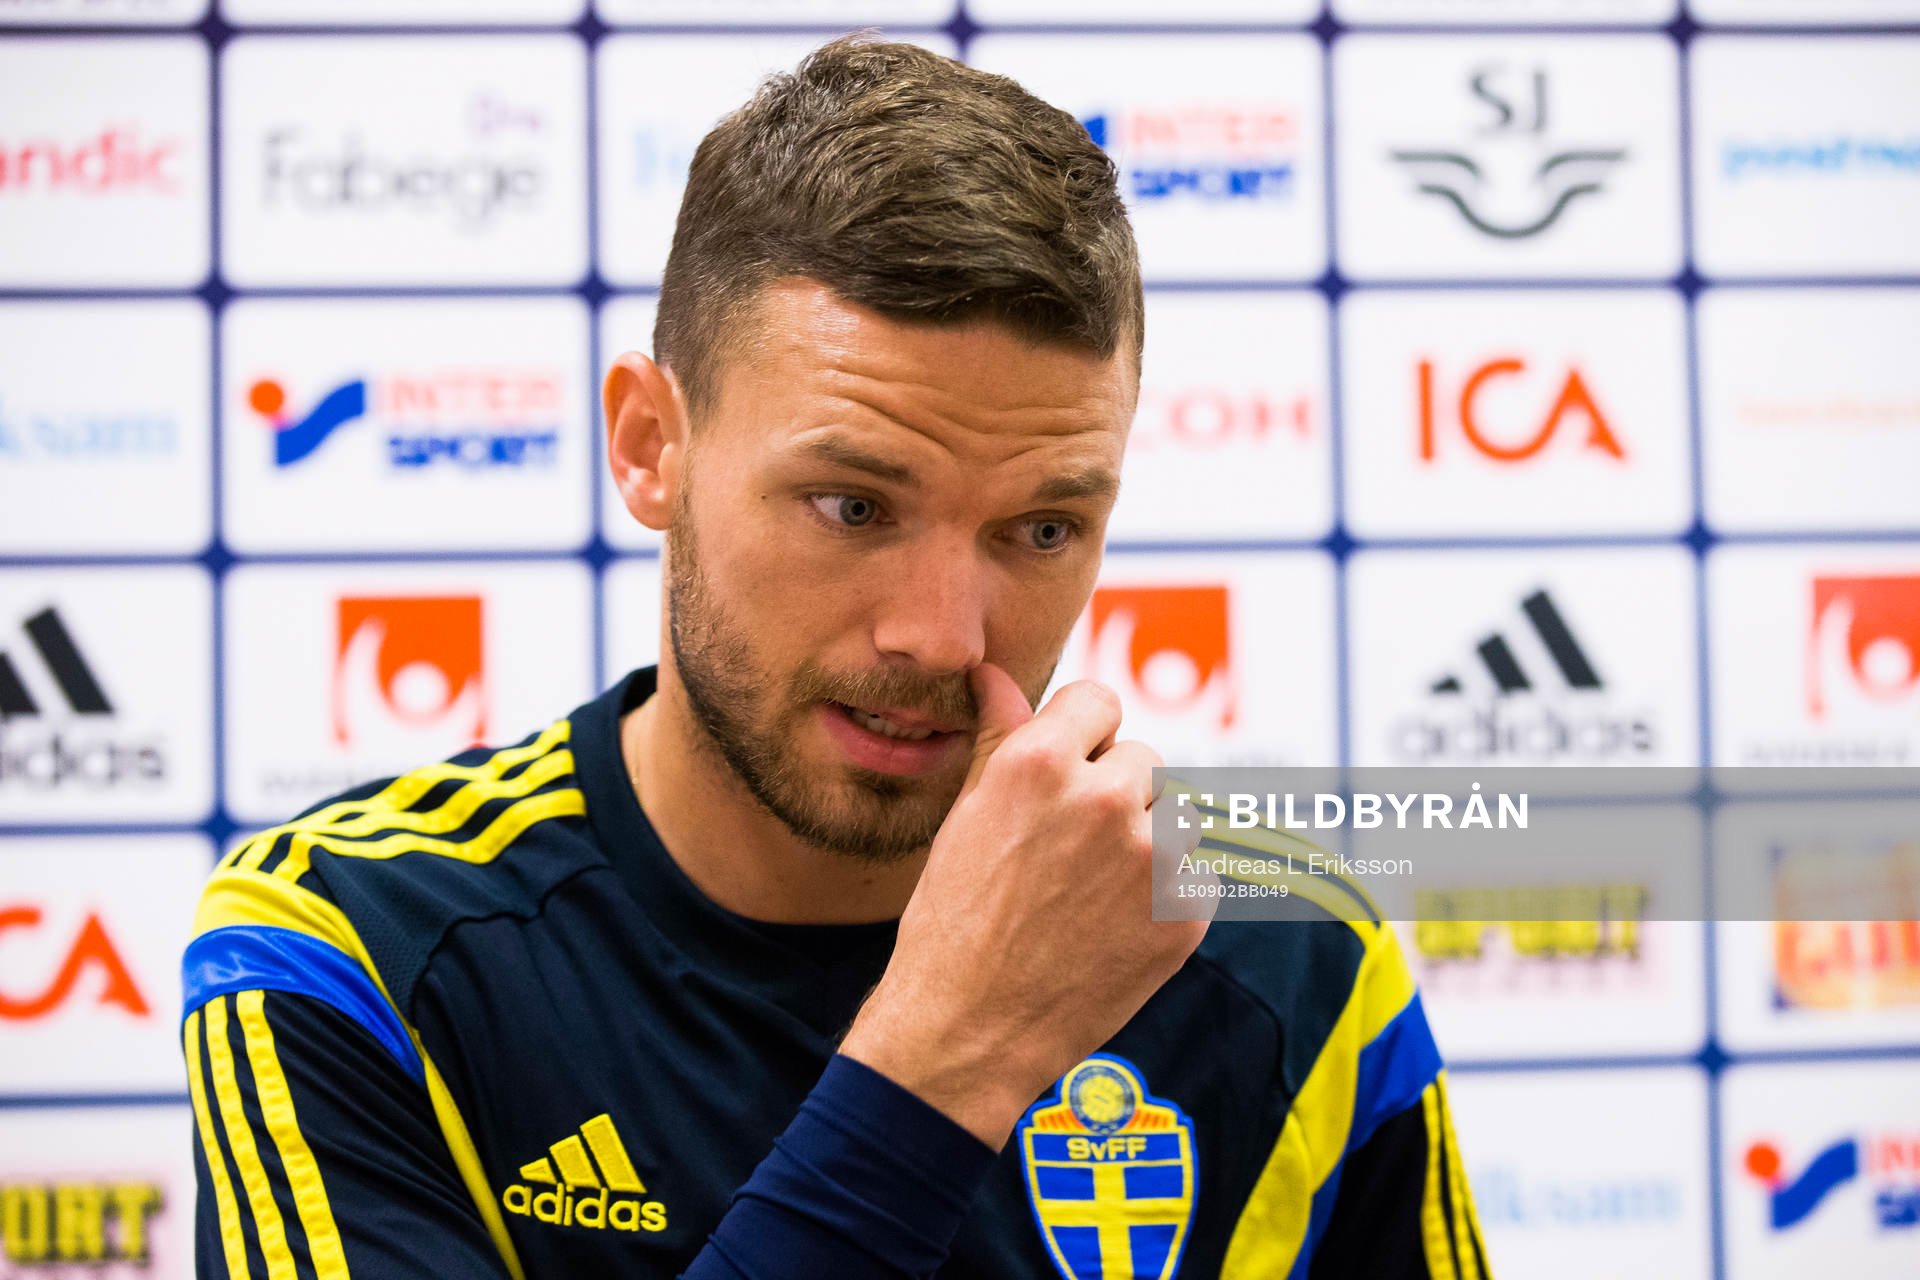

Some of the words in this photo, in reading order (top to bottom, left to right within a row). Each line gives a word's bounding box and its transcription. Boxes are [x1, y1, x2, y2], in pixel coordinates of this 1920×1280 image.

[1416, 358, 1628, 464] ICA
[387, 433, 557, 471] SPORT
[1066, 1137, 1147, 1161] SvFF
[502, 1182, 668, 1232] adidas
